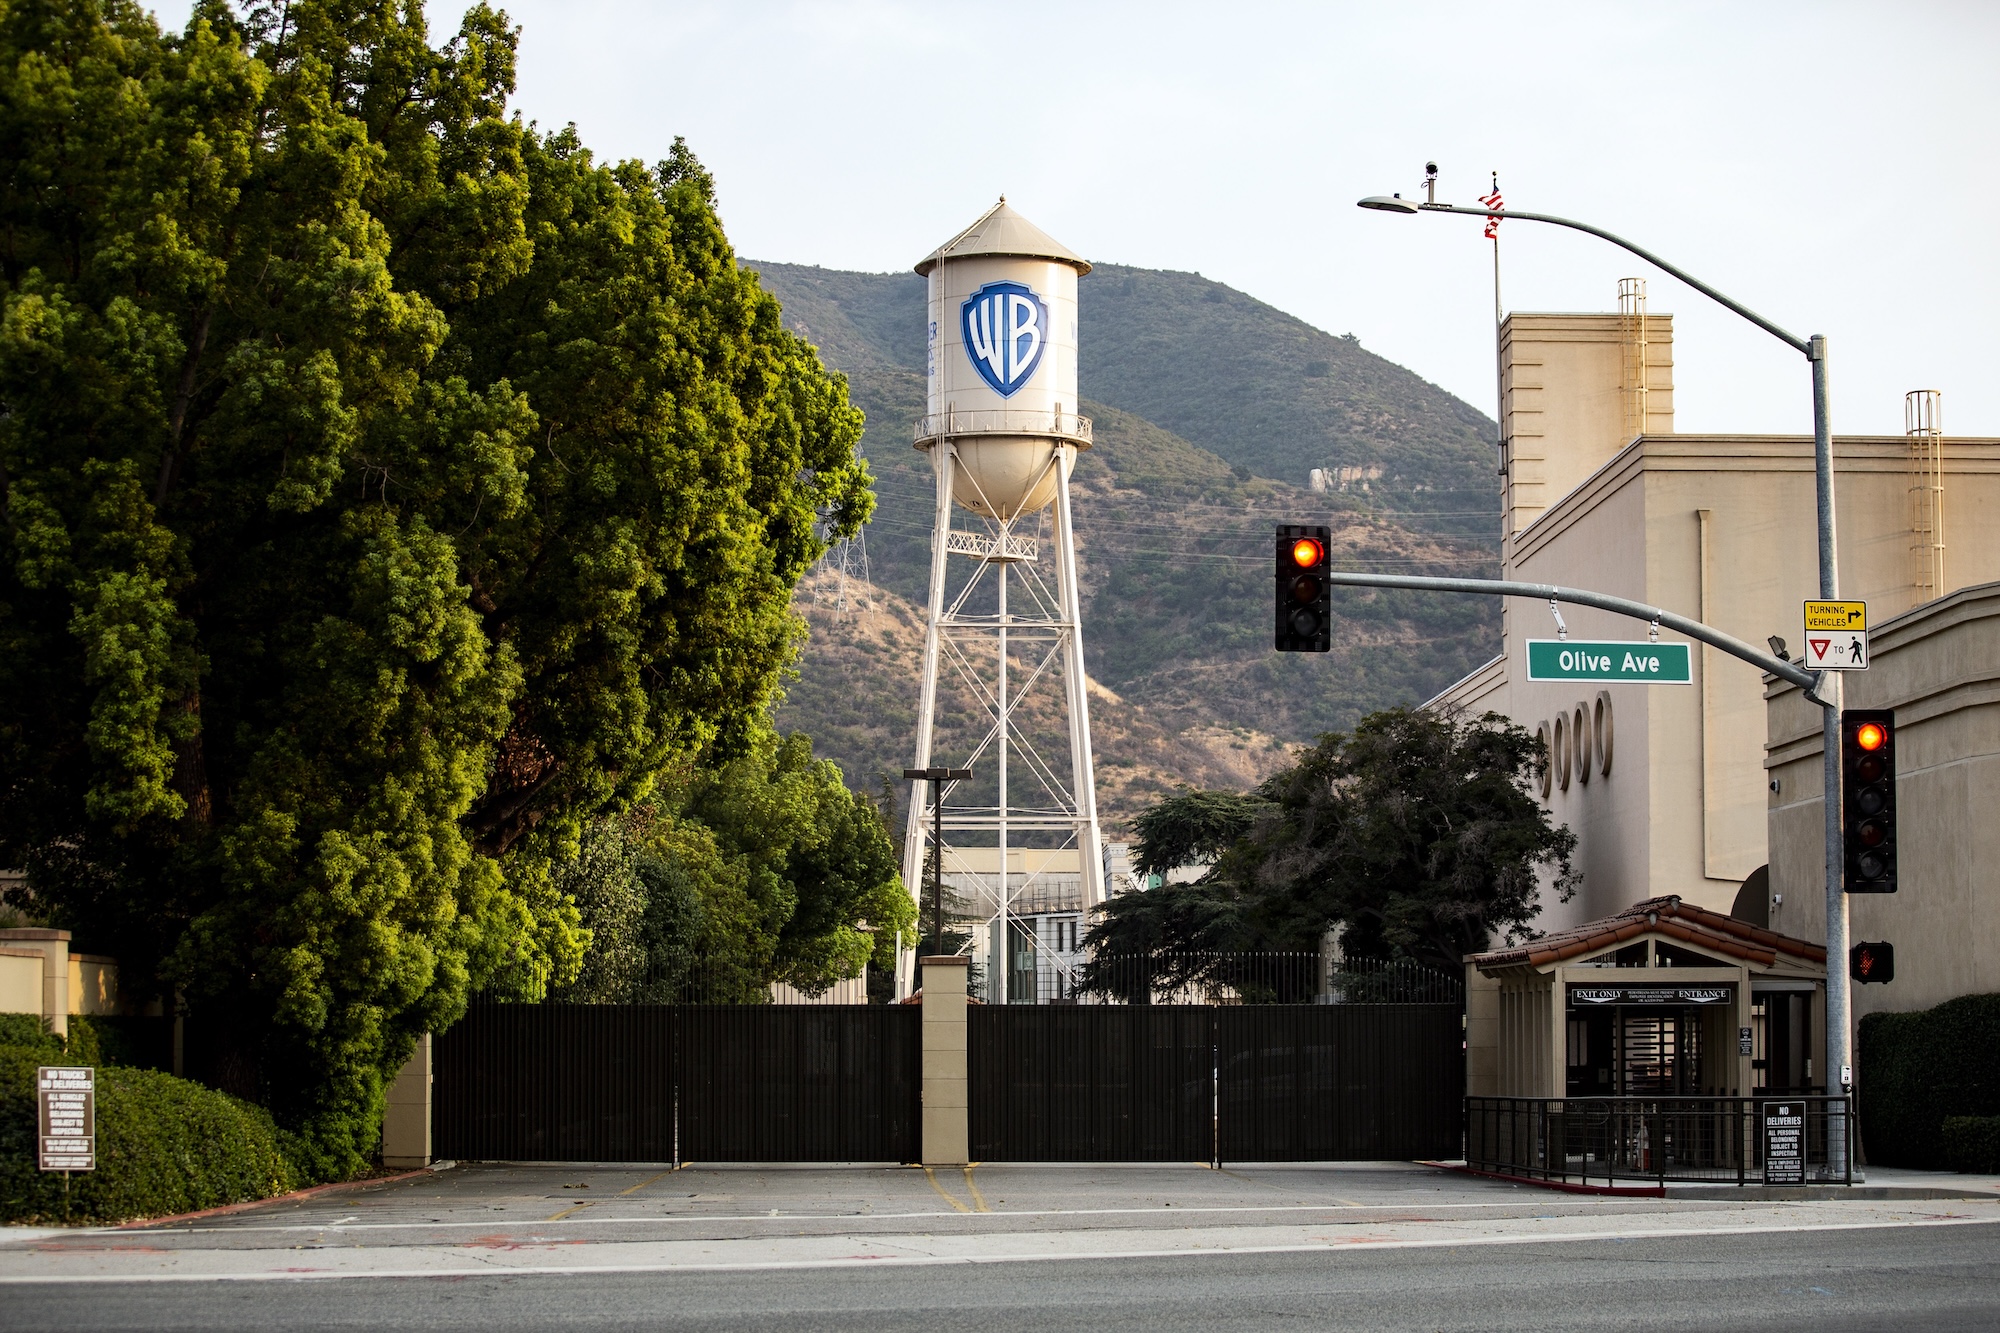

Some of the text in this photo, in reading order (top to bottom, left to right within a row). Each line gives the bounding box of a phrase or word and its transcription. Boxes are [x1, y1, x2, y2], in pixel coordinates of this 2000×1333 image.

[969, 294, 1041, 385] WB
[1809, 606, 1845, 614] TURNING
[1808, 618, 1846, 626] VEHICLES
[1834, 646, 1844, 654] TO
[1559, 650, 1660, 673] Olive Ave
[47, 1070, 86, 1080] NO TRUCKS
[41, 1080, 92, 1090] NO DELIVERIES
[1779, 1106, 1789, 1115] NO
[1767, 1117, 1801, 1125] DELIVERIES
